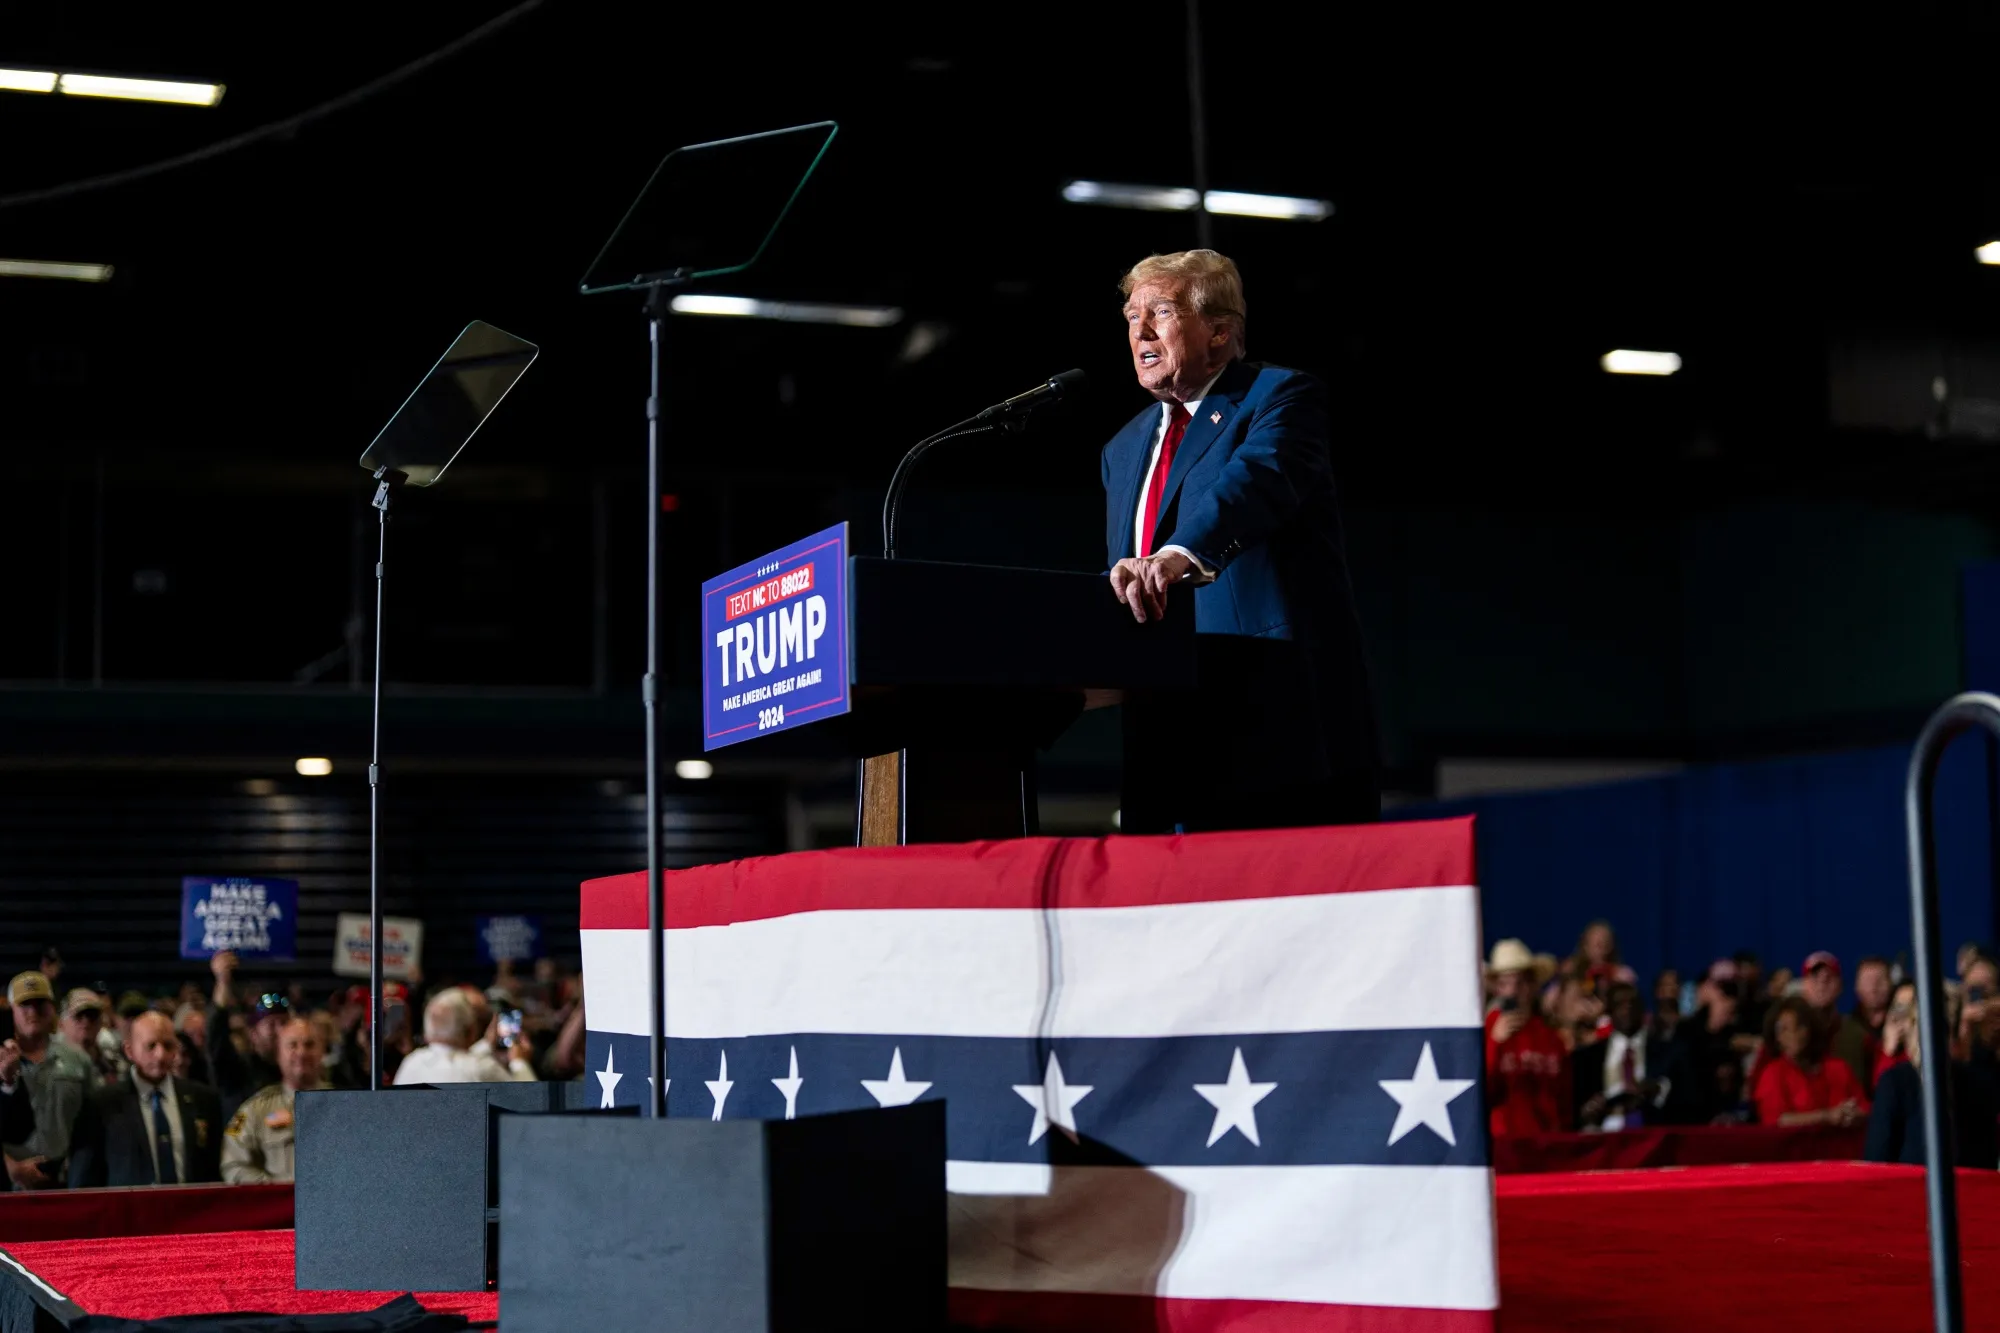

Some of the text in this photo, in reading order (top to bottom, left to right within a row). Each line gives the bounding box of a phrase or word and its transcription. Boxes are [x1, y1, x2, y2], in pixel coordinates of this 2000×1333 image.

[730, 568, 810, 617] TEXT NC TO 88022
[716, 595, 827, 687] TRUMP
[722, 668, 822, 712] MAKE AMERICA GREAT AGAIN!
[758, 704, 785, 730] 2024
[210, 883, 266, 899] MAKE
[194, 898, 281, 920] AMERICA
[204, 914, 269, 932] GREAT
